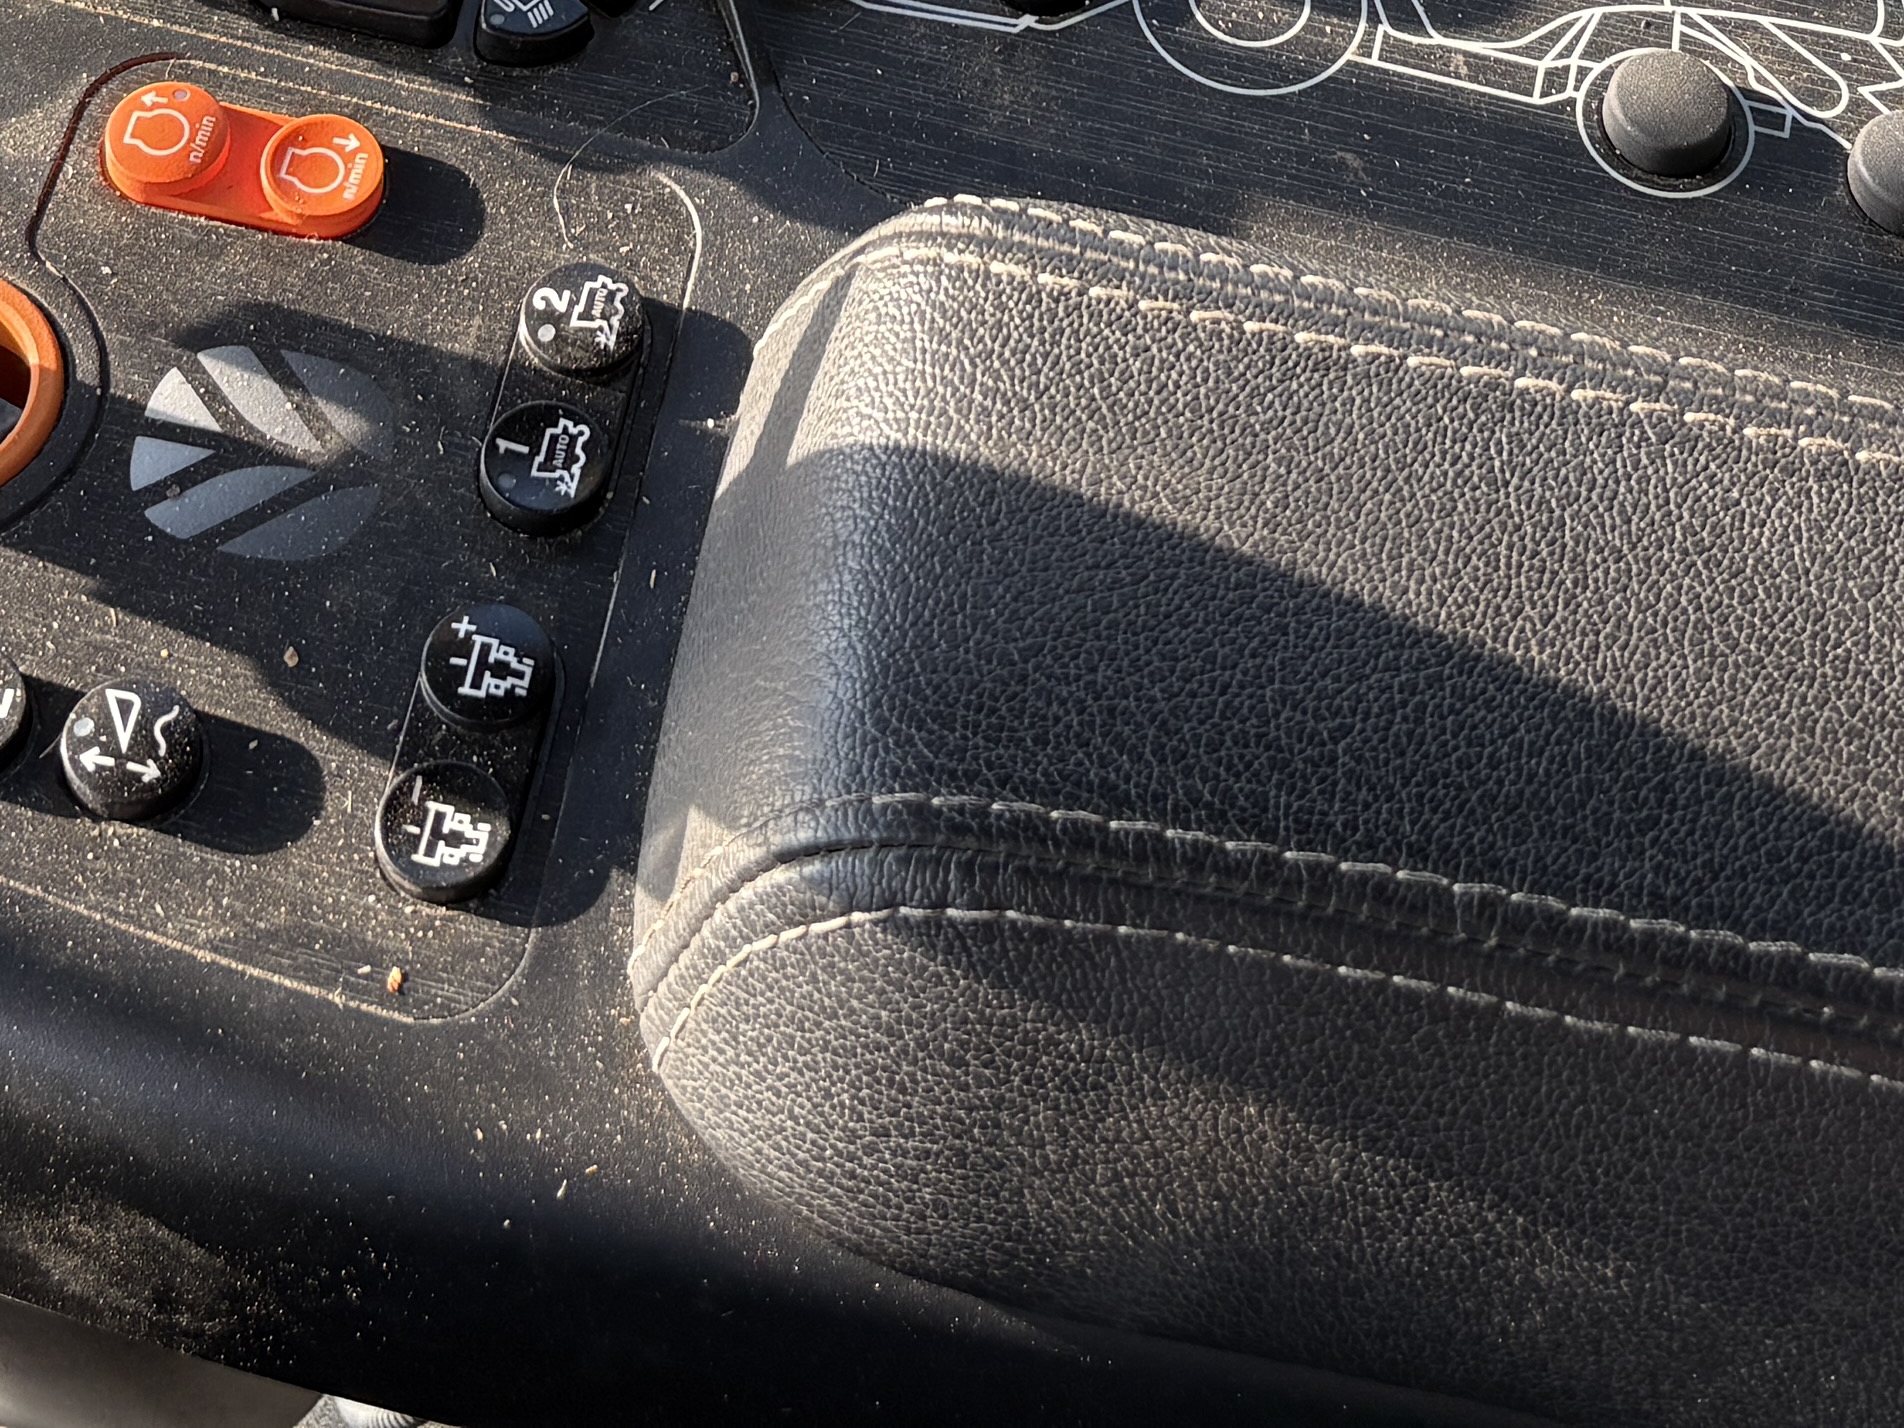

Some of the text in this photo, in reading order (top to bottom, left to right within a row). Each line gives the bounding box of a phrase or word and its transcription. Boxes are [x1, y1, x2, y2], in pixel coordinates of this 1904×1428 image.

[189, 115, 216, 164] n/min
[343, 152, 369, 201] n/min
[532, 287, 571, 313] 2
[592, 288, 608, 318] AUTO
[496, 437, 530, 454] 1
[552, 434, 570, 468] AUTO
